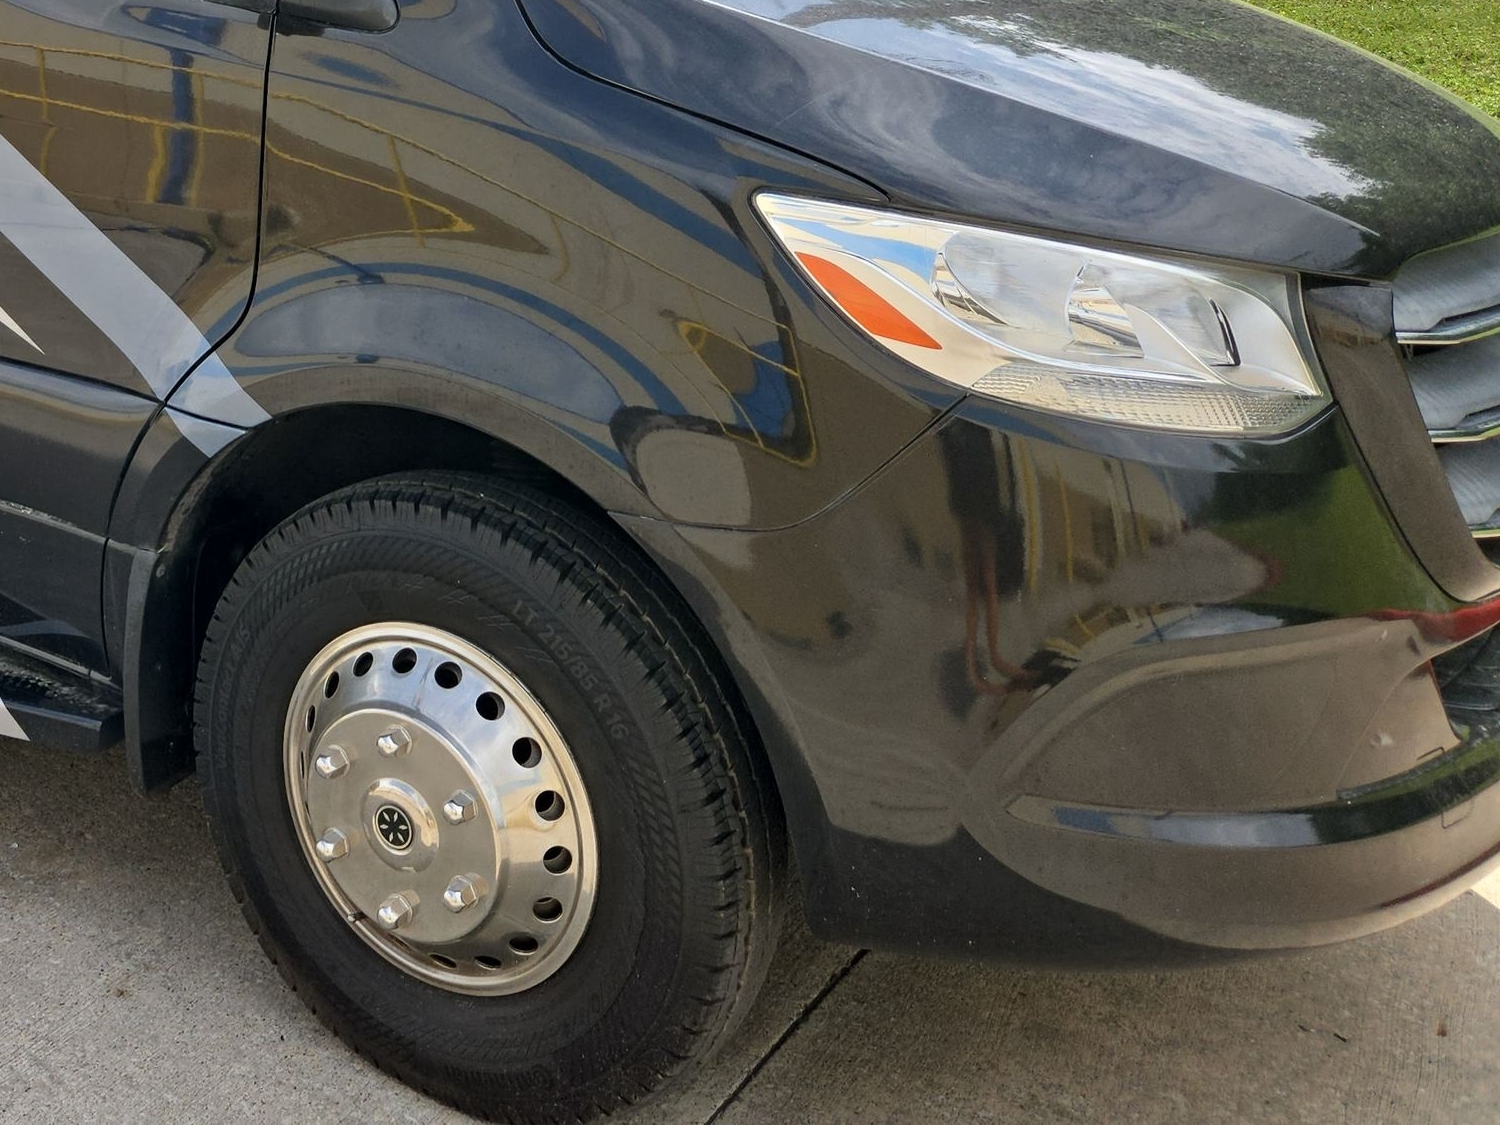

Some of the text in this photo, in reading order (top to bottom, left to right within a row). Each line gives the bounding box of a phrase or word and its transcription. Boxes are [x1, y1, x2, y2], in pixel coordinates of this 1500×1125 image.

[511, 599, 630, 740] LT 215/85 R 16
